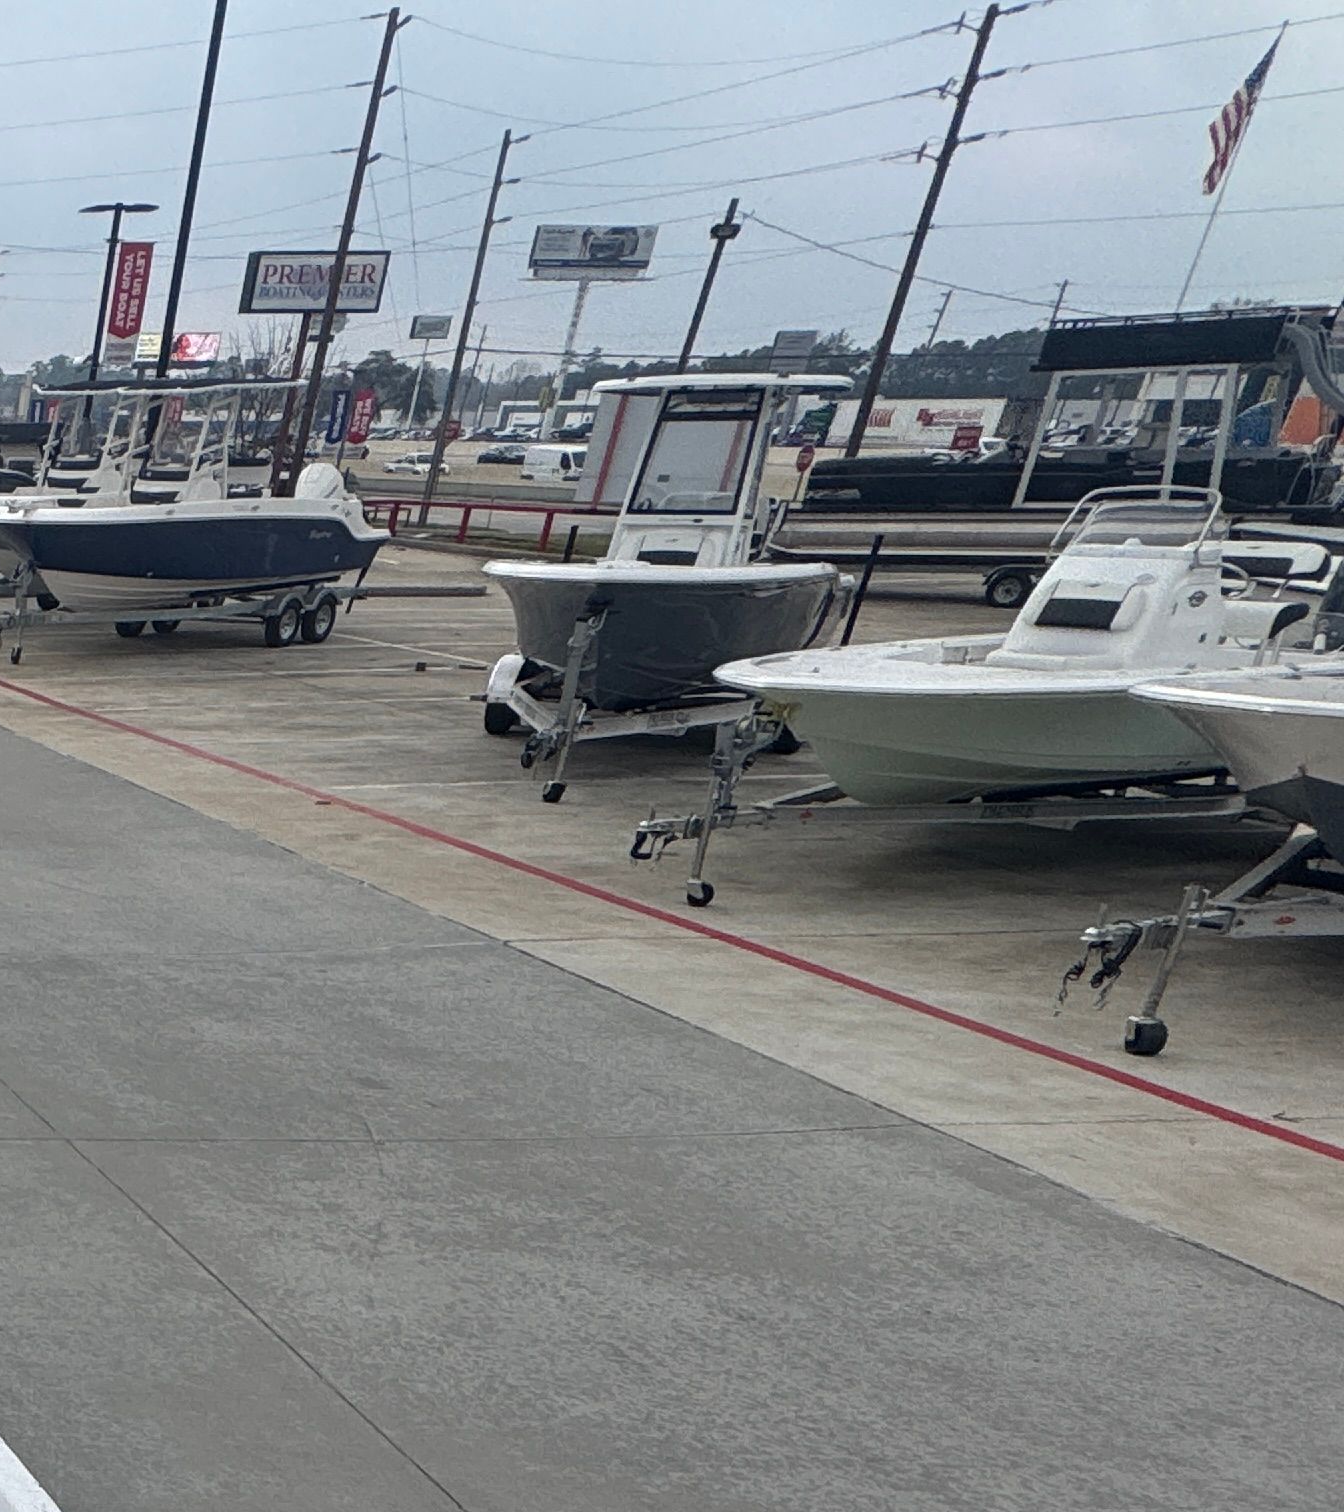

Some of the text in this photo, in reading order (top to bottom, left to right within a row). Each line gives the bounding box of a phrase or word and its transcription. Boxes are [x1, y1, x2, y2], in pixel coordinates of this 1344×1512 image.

[120, 252, 135, 290] YOUR
[261, 263, 377, 285] PREMER
[126, 250, 147, 330] LET US SELL
[115, 292, 129, 328] BOAT
